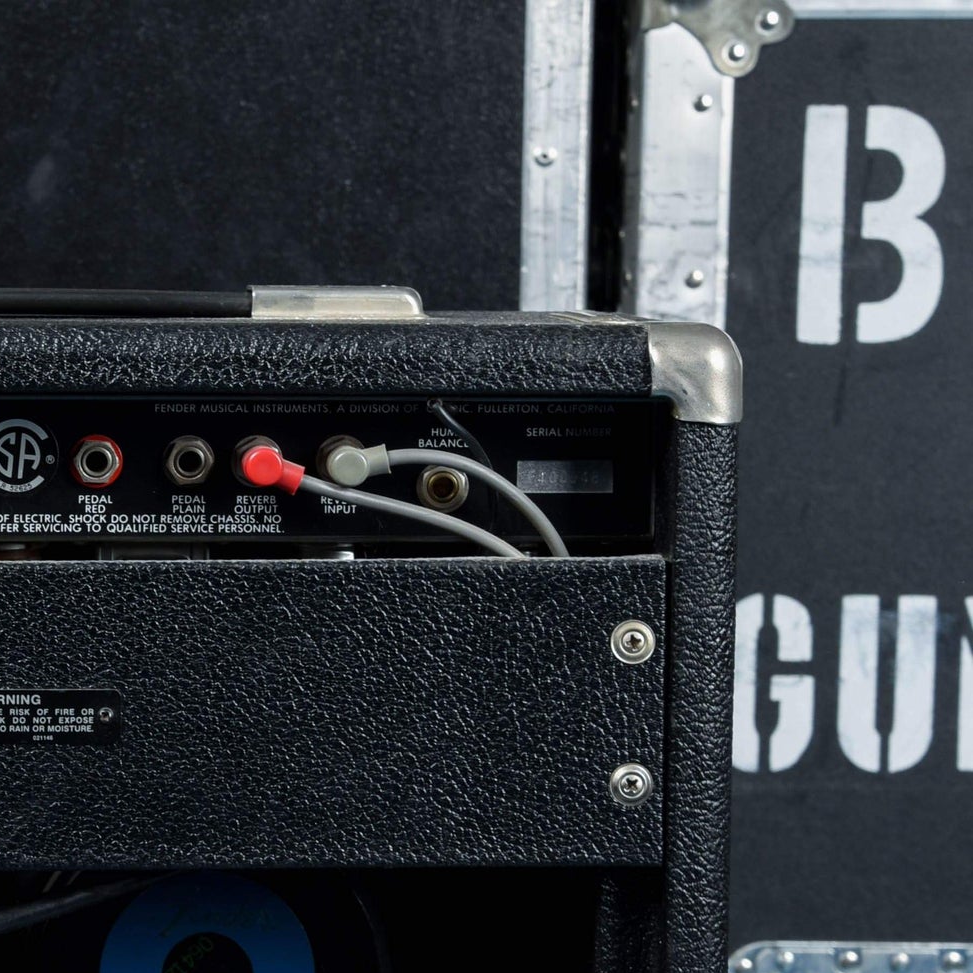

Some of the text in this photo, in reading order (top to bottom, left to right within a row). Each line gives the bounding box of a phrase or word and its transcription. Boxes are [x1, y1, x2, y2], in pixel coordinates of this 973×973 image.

[795, 103, 948, 346] B
[154, 403, 196, 413] FENDER
[200, 403, 249, 413] MUSICAL
[337, 403, 345, 413] A
[349, 403, 399, 413] DIVISION
[404, 403, 417, 413] OF
[547, 403, 615, 413] CALIFORNIA
[526, 428, 612, 437] SERIAL NUMBER
[78, 495, 113, 504] PEDAL
[172, 495, 207, 504] PEDAL
[236, 495, 276, 505] REVERB
[85, 505, 106, 514] RED
[173, 505, 205, 514] PLAIN
[234, 505, 277, 514] OUTPUT
[324, 505, 358, 514] INPUT
[13, 514, 62, 523] ELECTRIC
[69, 514, 107, 523] SHOCK
[111, 514, 128, 523] DO
[133, 514, 156, 523] NOT
[160, 514, 206, 523] REMOVE
[210, 514, 259, 523] CHASSIS.
[263, 514, 282, 523] NO
[23, 523, 82, 533] SERVICING
[86, 523, 102, 533] TO
[107, 523, 167, 533] QUALIFIED
[171, 523, 214, 533] SERVICE
[218, 523, 285, 533] PERSONNEL.
[732, 594, 973, 774] GU
[9, 708, 30, 716] RISK
[36, 708, 49, 716] OF
[54, 708, 75, 716] FIRE
[81, 708, 95, 716] OR
[9, 725, 30, 733] RAIN
[32, 725, 45, 733] OR
[47, 725, 94, 733] MOISTURE.
